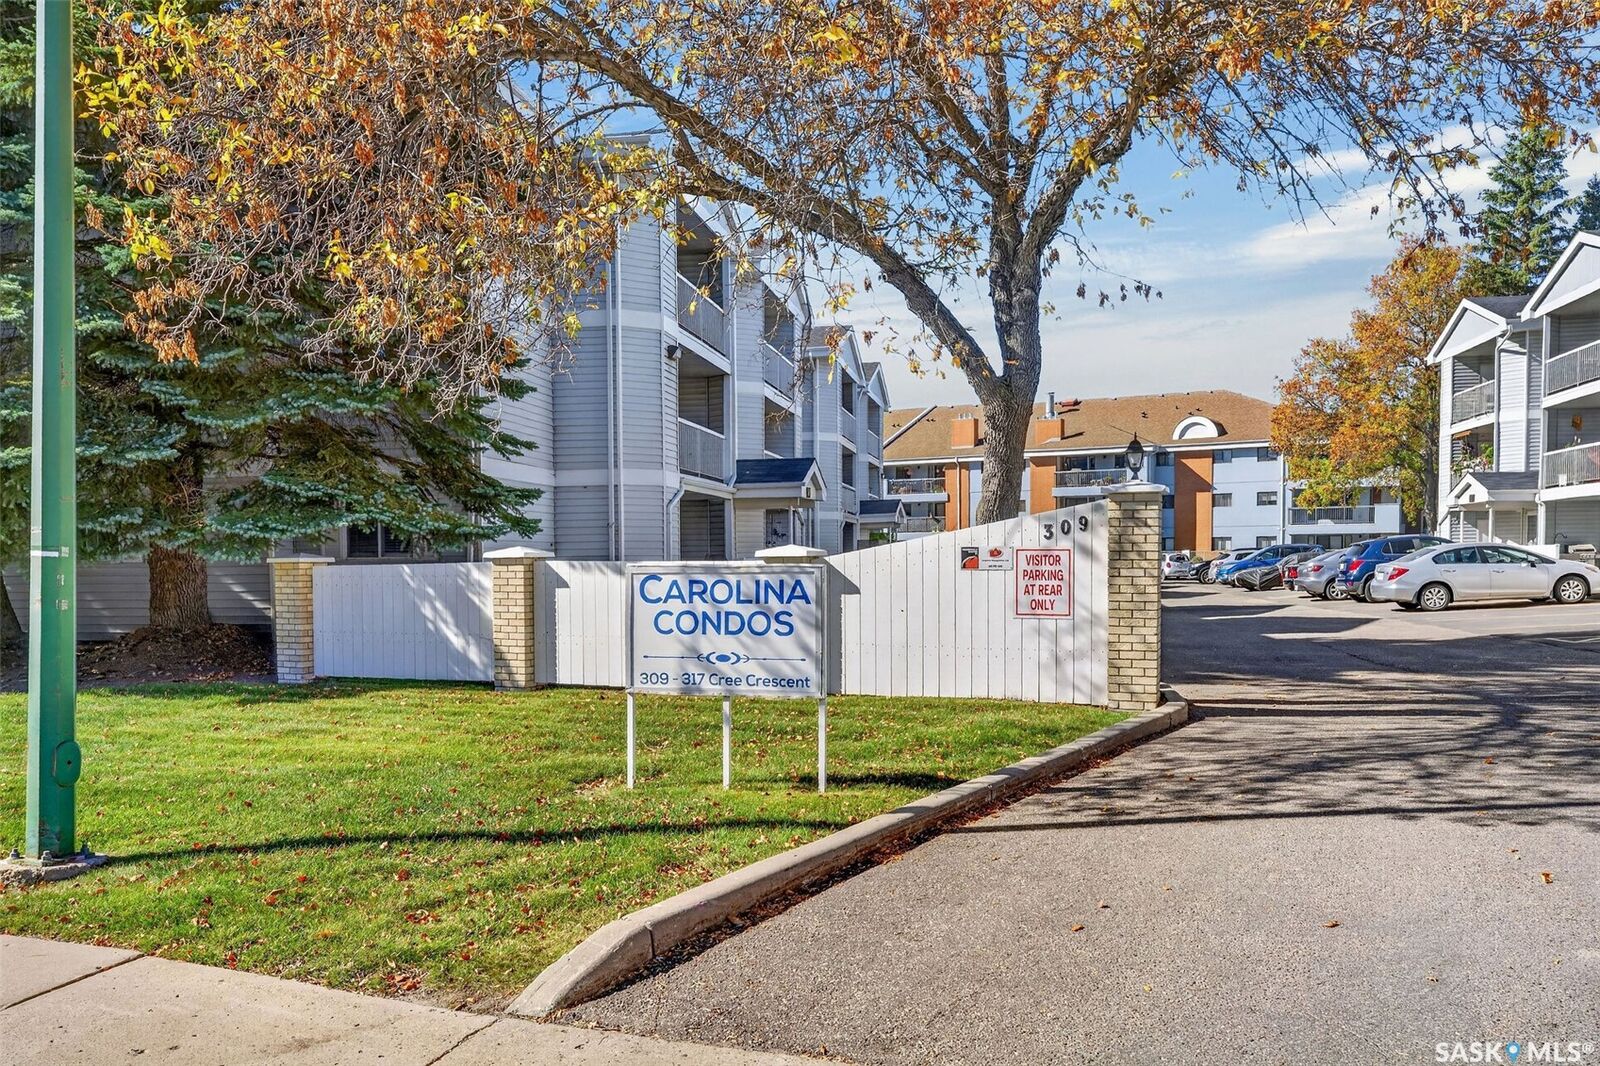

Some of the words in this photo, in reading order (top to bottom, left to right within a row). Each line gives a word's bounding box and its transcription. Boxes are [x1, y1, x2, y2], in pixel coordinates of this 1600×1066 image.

[1043, 515, 1089, 541] 309
[1025, 554, 1061, 566] VISITOR
[1022, 569, 1064, 582] PARKING
[639, 574, 811, 604] CAROLINA
[1023, 584, 1037, 596] AT
[1038, 584, 1063, 596] REAR
[1030, 599, 1056, 611] ONLY
[653, 610, 795, 636] CONDOS
[640, 672, 669, 686] 309
[682, 672, 706, 686] 317
[708, 673, 742, 687] Cree
[745, 674, 811, 688] Crescent
